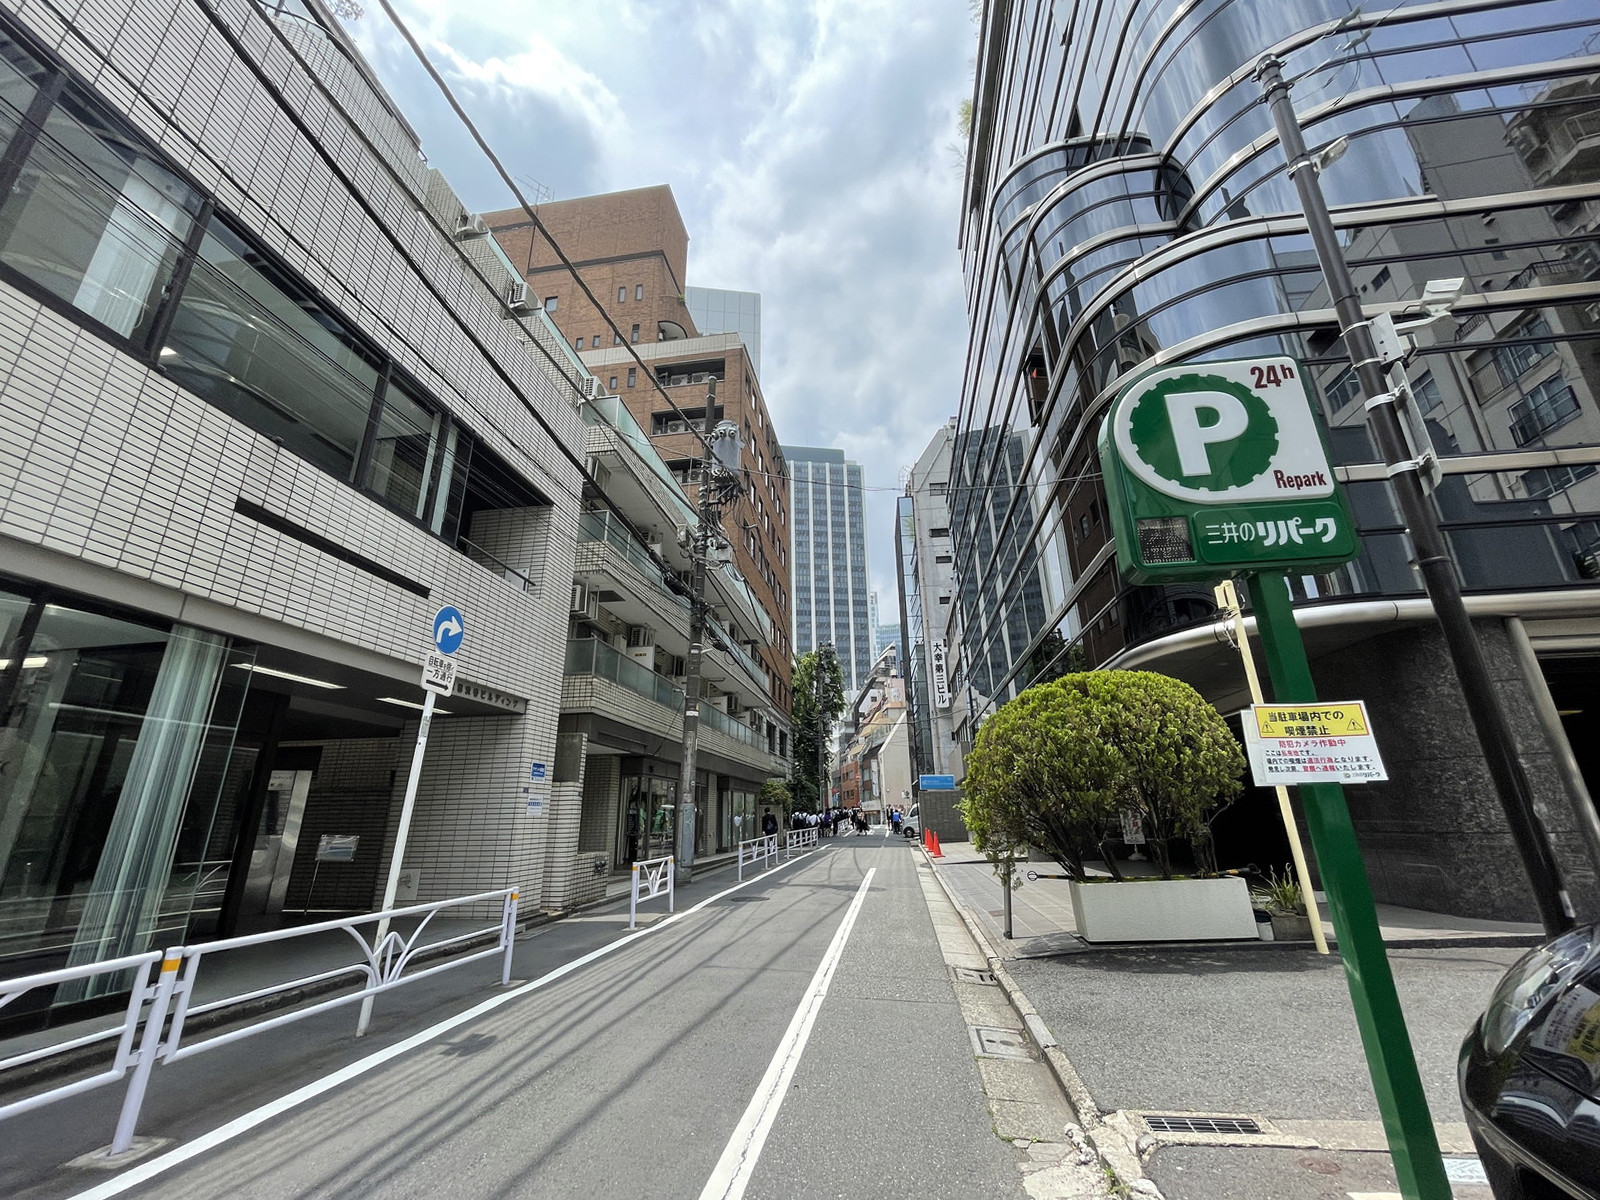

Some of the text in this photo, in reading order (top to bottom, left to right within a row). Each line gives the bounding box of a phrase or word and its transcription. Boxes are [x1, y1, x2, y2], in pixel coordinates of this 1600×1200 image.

[1250, 364, 1295, 389] 24h
[1164, 391, 1249, 477] P
[1273, 469, 1327, 490] Repark
[1205, 517, 1337, 546] 三井のリパーク
[426, 669, 453, 684] 一方通行
[933, 642, 947, 705] 大幸第三ビル
[1268, 711, 1344, 722] 当駐車場内での
[1284, 725, 1331, 736] 喫煙禁止
[1278, 738, 1347, 748] 防犯カメラ作動中
